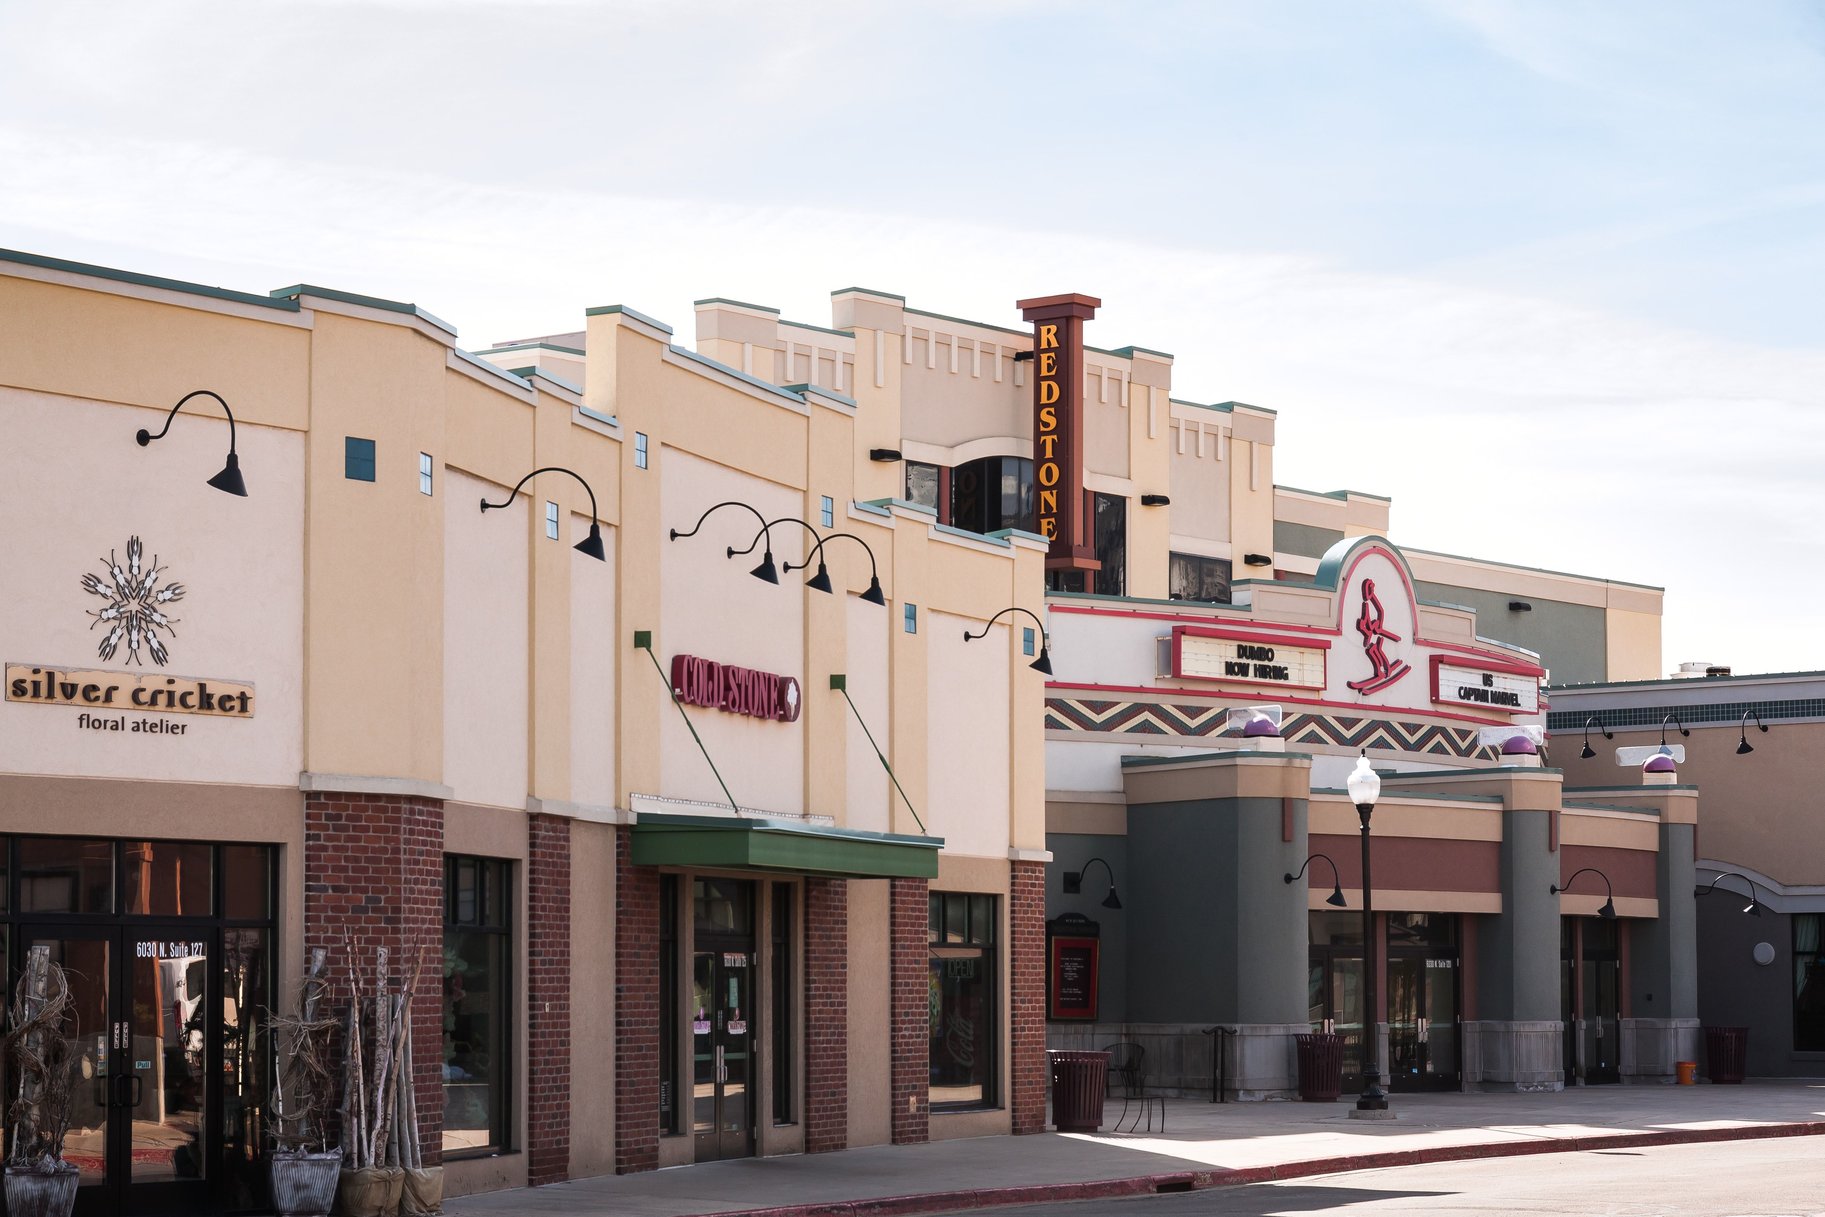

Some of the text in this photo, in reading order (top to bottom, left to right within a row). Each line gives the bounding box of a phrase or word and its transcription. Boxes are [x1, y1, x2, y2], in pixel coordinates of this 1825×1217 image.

[1039, 324, 1060, 541] REDSTONE
[1237, 644, 1274, 662] DUMBO
[1225, 661, 1289, 680] NOW HIRING
[1482, 673, 1493, 687] US
[12, 668, 253, 713] silver cricket
[681, 655, 780, 720] COLD STONE
[1458, 686, 1521, 707] CAPTAIN MARVEL
[78, 714, 187, 735] floral atelier
[136, 942, 203, 957] 6030 N. Suite 127
[949, 960, 974, 976] OPEN
